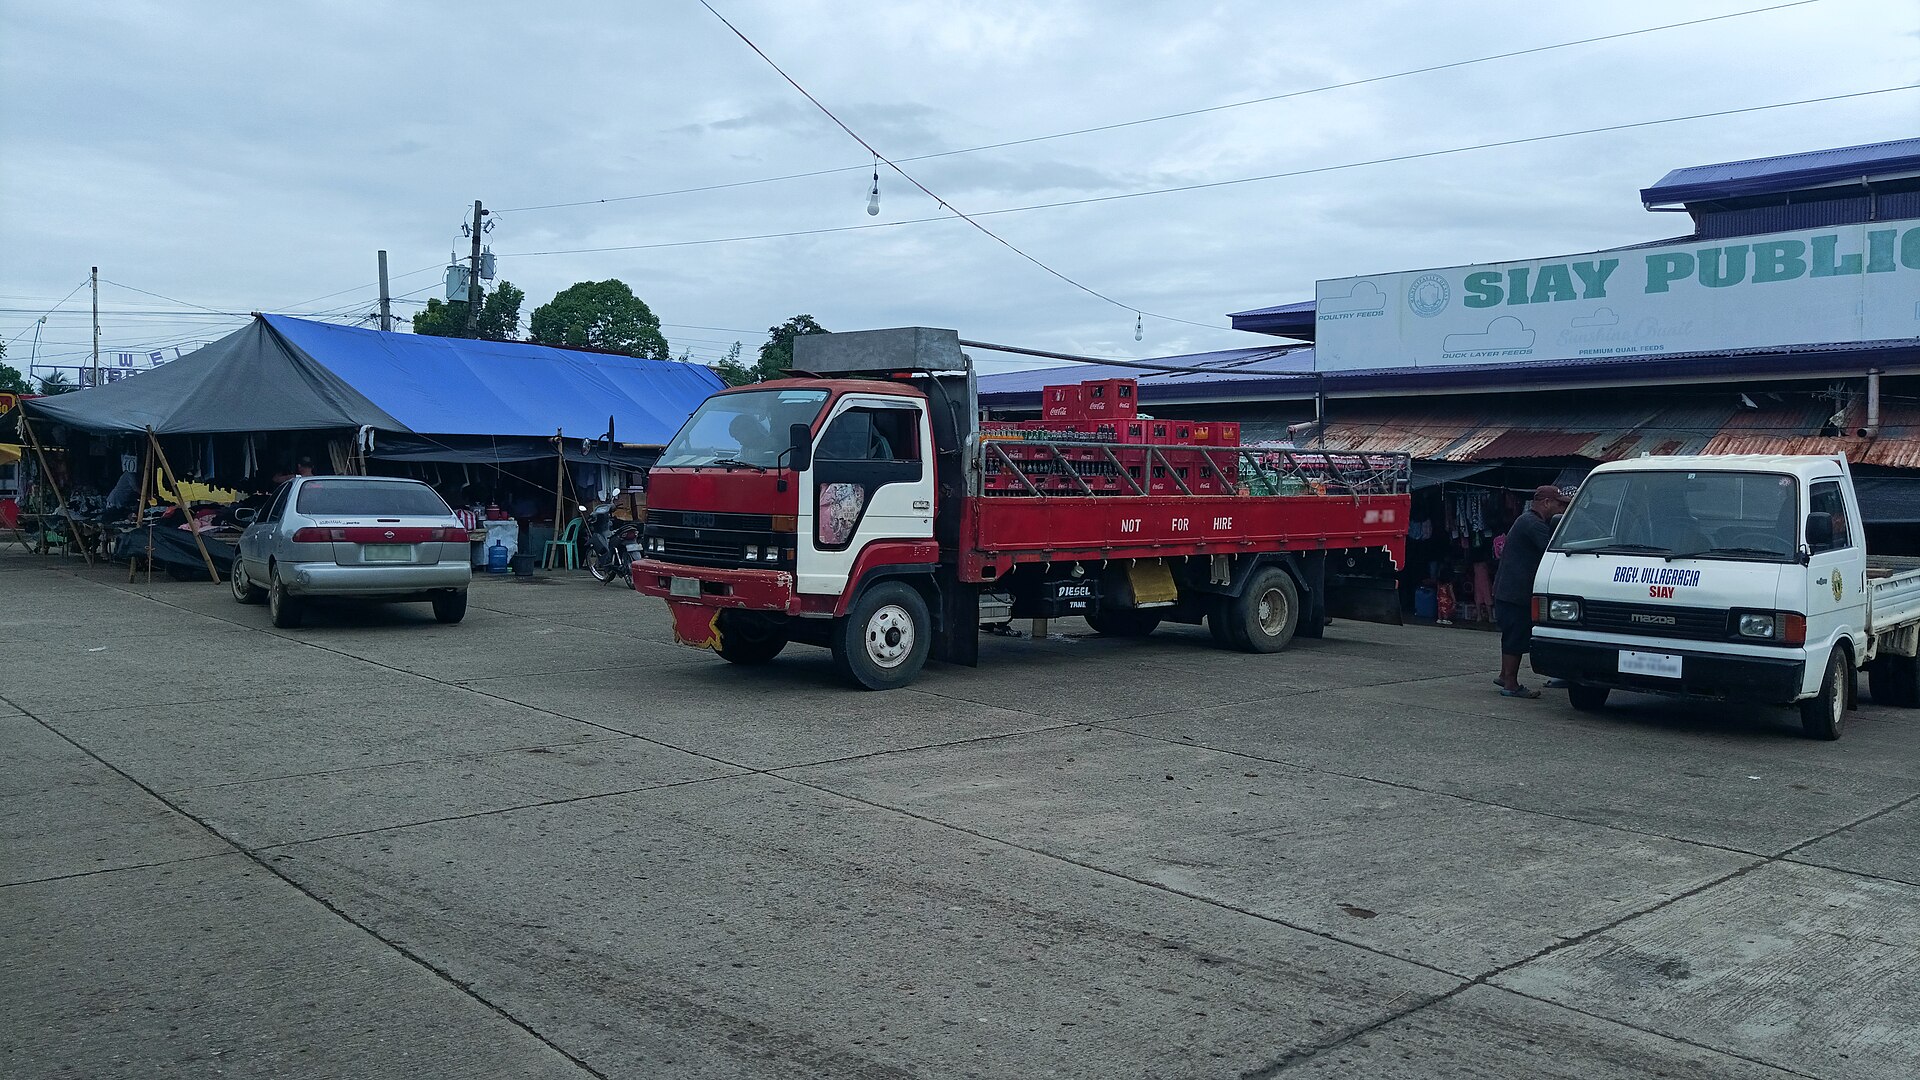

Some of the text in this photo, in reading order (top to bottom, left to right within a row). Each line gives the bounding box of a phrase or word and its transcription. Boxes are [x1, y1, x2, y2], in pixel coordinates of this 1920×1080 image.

[1463, 258, 1620, 308] SIAY
[1318, 310, 1384, 321] POULTRY FEEDS
[1502, 348, 1533, 356] FEEDS
[1578, 344, 1665, 356] PREMIUM QUAIL FEEDS
[1121, 516, 1233, 533] NOT FOR HIRE
[1613, 566, 1701, 587] BRGY. VILLAGRACIA
[1058, 586, 1091, 597] DIESEL
[1649, 585, 1675, 599] SIAY
